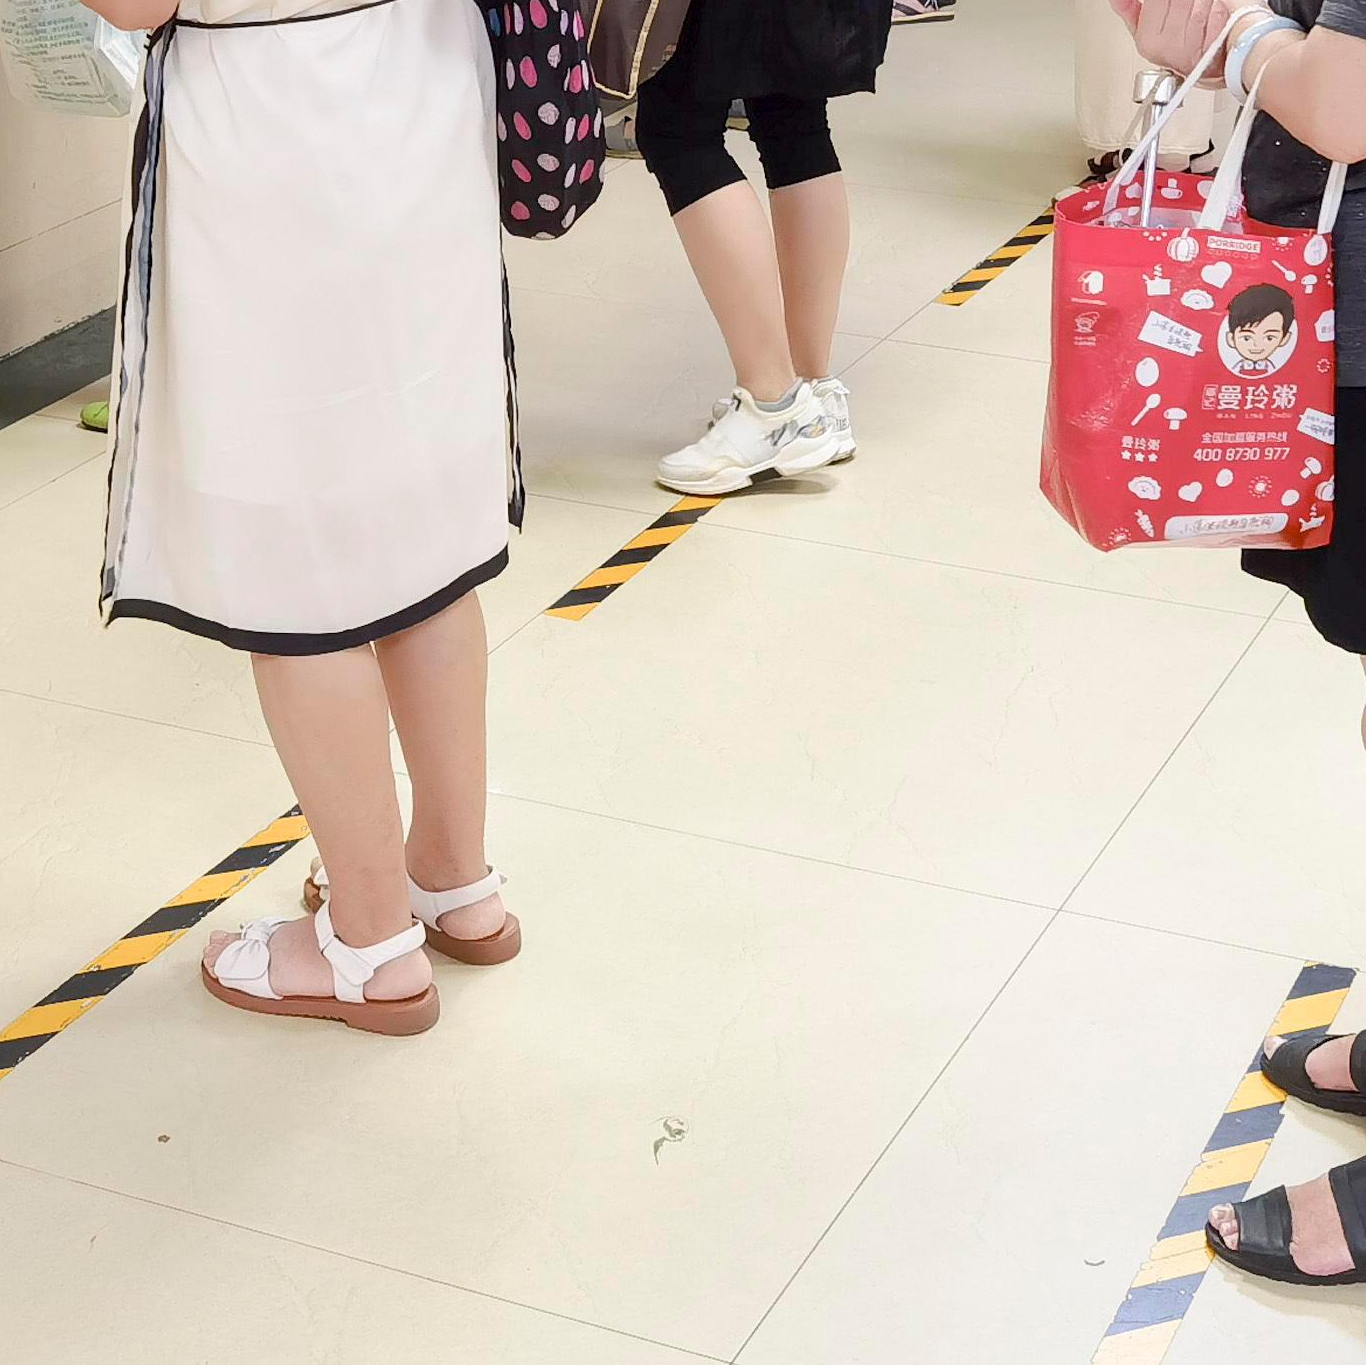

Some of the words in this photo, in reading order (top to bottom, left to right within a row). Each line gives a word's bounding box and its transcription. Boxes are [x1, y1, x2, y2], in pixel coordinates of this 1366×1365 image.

[1208, 237, 1260, 252] PORRIDGE
[1216, 384, 1298, 411] 曼玲粥
[1193, 448, 1223, 462] 400
[1225, 447, 1260, 461] 8730
[1264, 446, 1291, 460] 977
